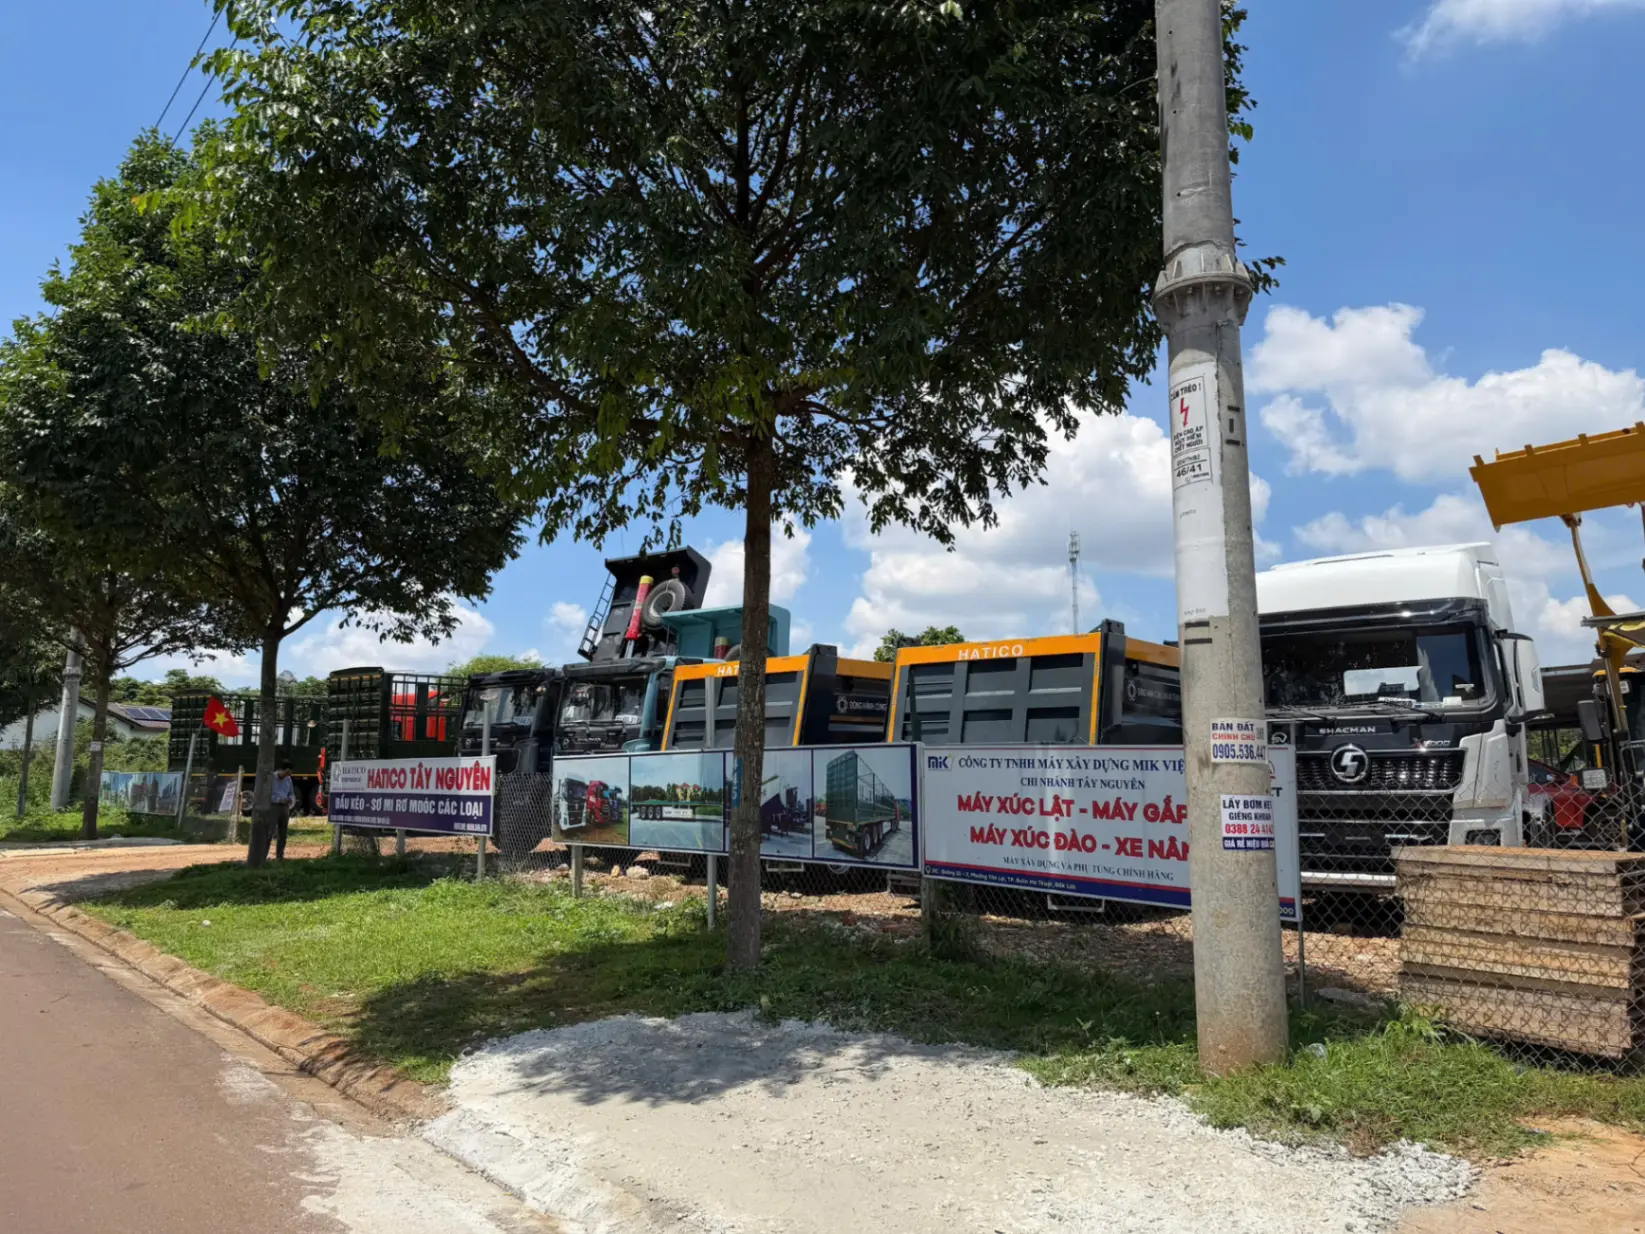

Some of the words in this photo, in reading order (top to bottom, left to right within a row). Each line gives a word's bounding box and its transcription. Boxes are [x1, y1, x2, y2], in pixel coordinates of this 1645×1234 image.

[1176, 464, 1202, 477] 46/41
[958, 644, 1024, 660] HATICO
[1212, 721, 1233, 731] BÁN
[1237, 721, 1254, 731] ĐẤT
[1319, 726, 1376, 734] SHACMAN
[958, 755, 987, 768] CÔNG
[990, 758, 1003, 769] TY
[1005, 758, 1035, 769] TNHH
[1038, 756, 1063, 770] MÁY
[1066, 756, 1092, 770] XÂY
[1093, 758, 1129, 773] DỰNG
[1132, 759, 1160, 771] MIK
[367, 767, 407, 789] HATICO
[410, 762, 432, 790] TÂY
[436, 760, 491, 790] NGUYÊN
[1020, 777, 1038, 786] CHI
[1040, 776, 1075, 787] NHÁNH
[1076, 776, 1098, 788] TÂY
[1100, 777, 1145, 790] NGUYÊN
[350, 796, 365, 810] KÉO
[383, 798, 394, 811] MI
[438, 798, 457, 815] CÁC
[460, 801, 483, 820] LOẠI
[957, 791, 994, 812] MÁY
[996, 793, 1036, 815] XÚC
[1039, 794, 1075, 822] LẬT
[1092, 797, 1138, 821] MÁY
[1223, 796, 1240, 809] LẤY
[1225, 824, 1248, 834] 0388
[1250, 824, 1260, 834] 24
[970, 823, 1008, 845] MÁY
[1010, 826, 1050, 849] XÚC
[1054, 828, 1097, 853] ĐÀO
[1115, 837, 1144, 857] XE
[1003, 856, 1019, 865] MÁY
[1020, 857, 1036, 866] XÂY
[1037, 858, 1060, 869] DỰNG
[1062, 861, 1072, 870] VÀ
[1074, 863, 1088, 873] PHỤ
[1092, 864, 1115, 875] TÙNG
[1117, 866, 1145, 878] CHÍNH
[1147, 869, 1174, 881] HÃNG
